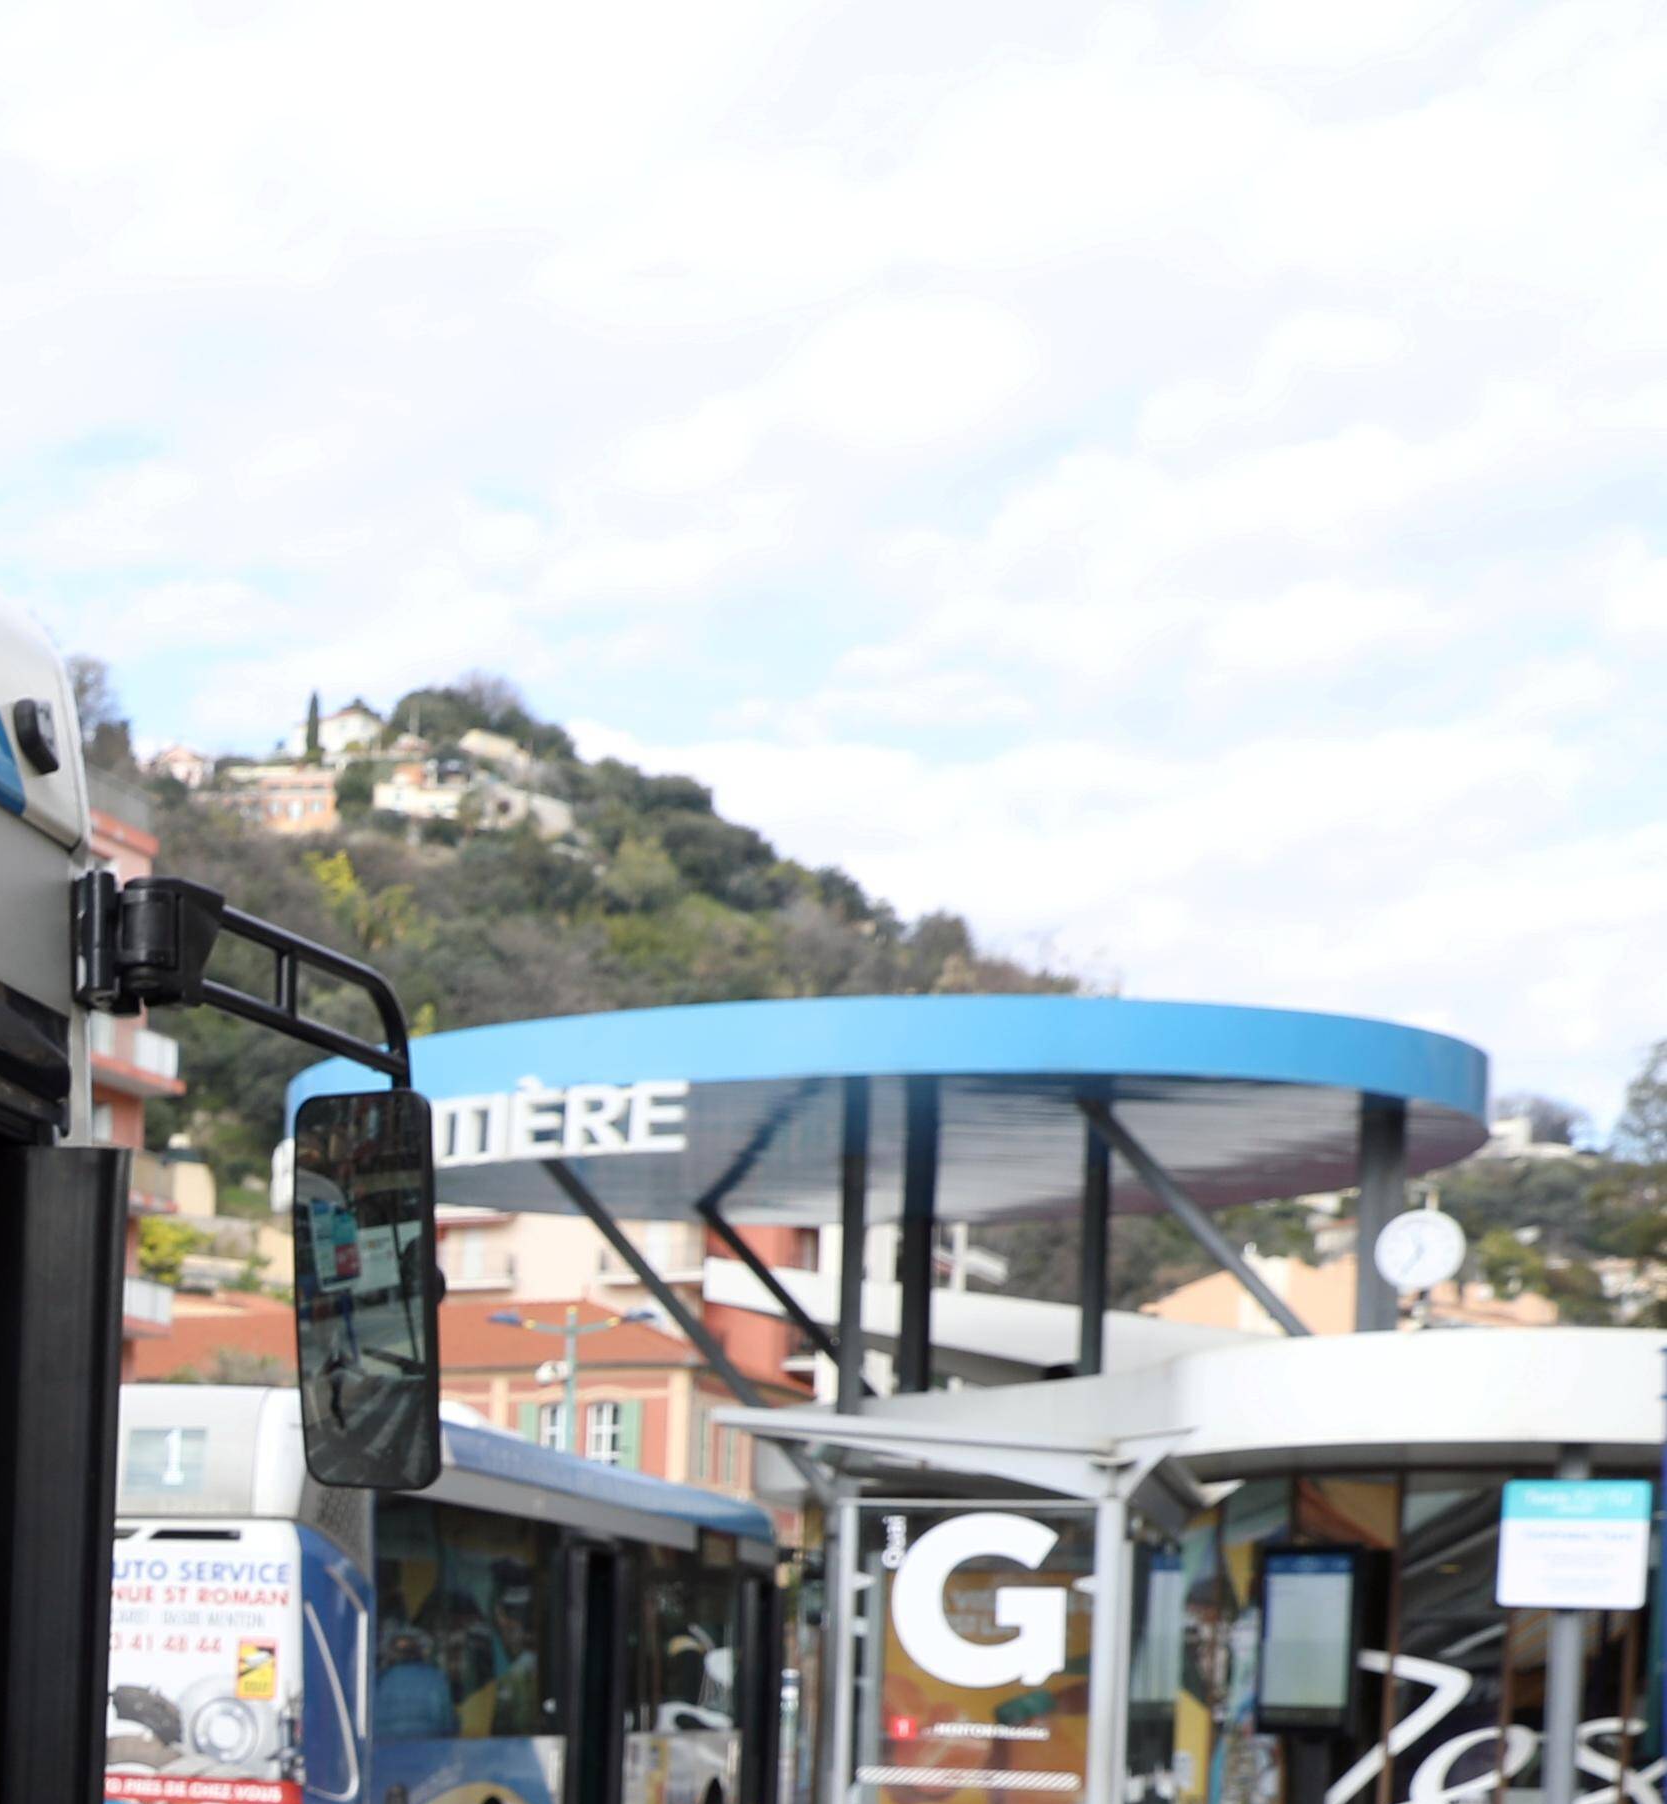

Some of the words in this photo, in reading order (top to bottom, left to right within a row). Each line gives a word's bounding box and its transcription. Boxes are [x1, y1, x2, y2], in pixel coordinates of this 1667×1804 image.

[162, 1426, 185, 1486] 1
[180, 1560, 291, 1586] SERVICE
[196, 1586, 291, 1607] ROMAN
[892, 1511, 1067, 1690] G
